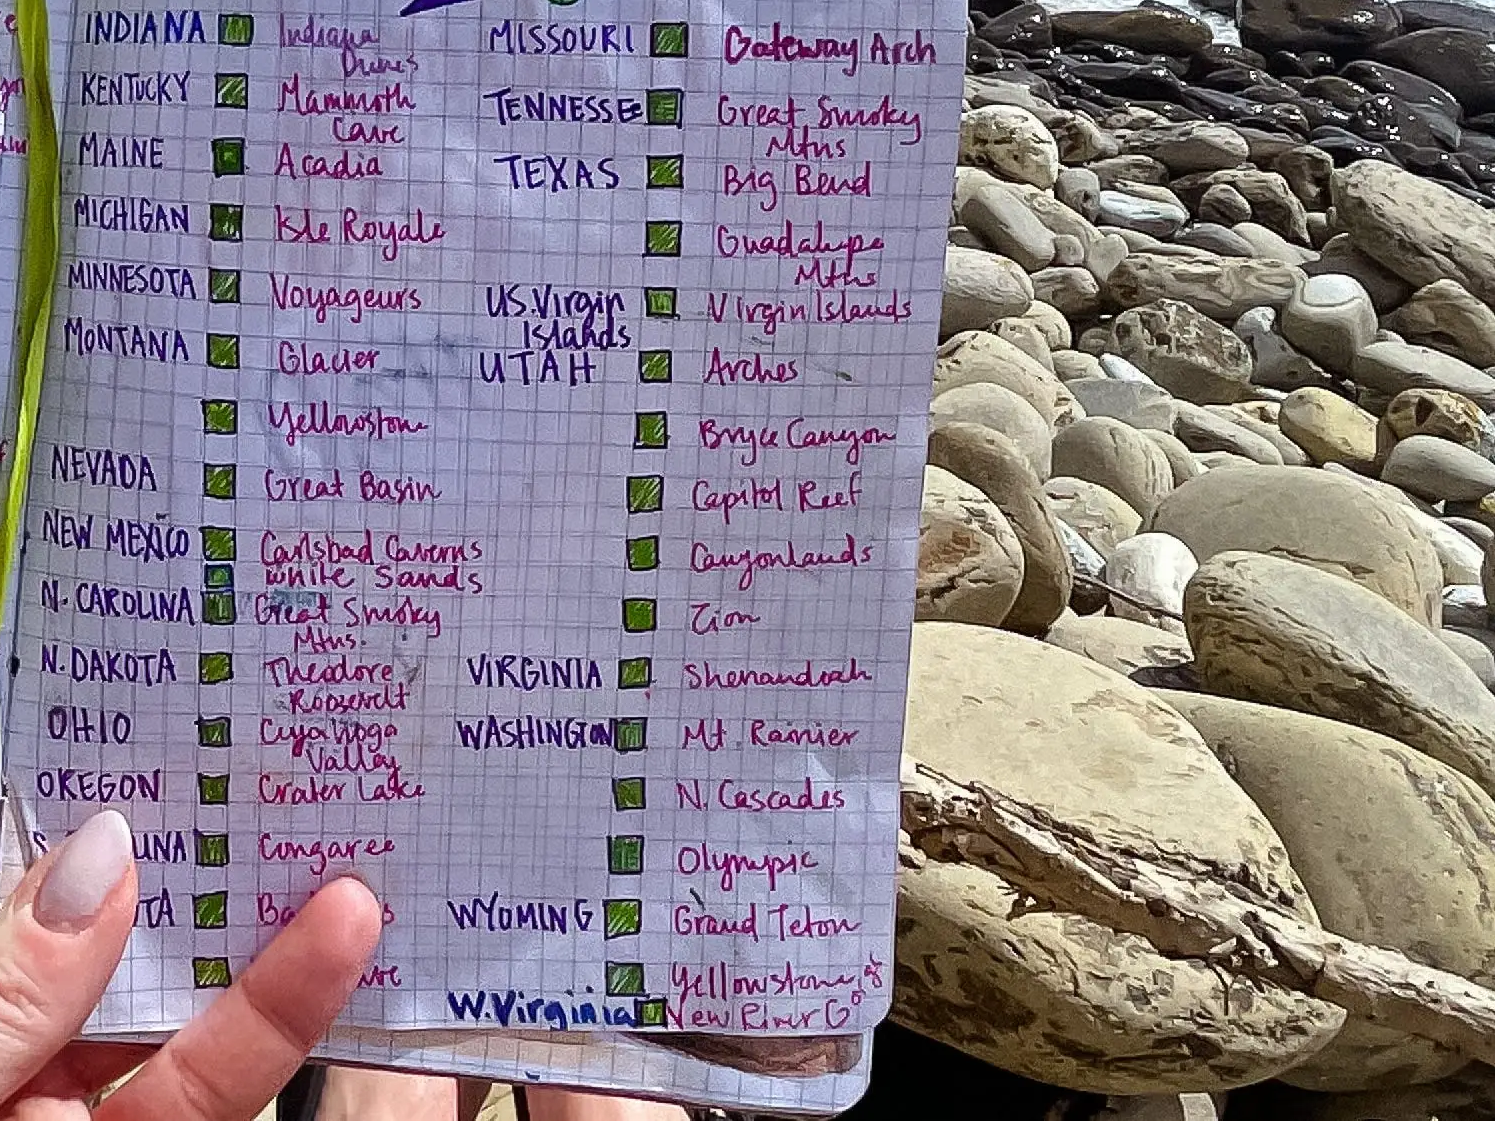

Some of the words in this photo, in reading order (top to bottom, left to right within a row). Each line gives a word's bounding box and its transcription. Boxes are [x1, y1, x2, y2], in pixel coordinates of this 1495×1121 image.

[85, 10, 206, 45] INDIANA
[279, 12, 380, 49] Indiana
[489, 21, 634, 54] MISSOURI
[724, 23, 858, 76] Gateway
[870, 31, 937, 64] Arch
[82, 71, 191, 106] KENTUCKY
[278, 73, 417, 116] Mammoth
[332, 117, 405, 143] Cave
[717, 95, 805, 129] Great
[817, 96, 921, 145] Smoky
[78, 133, 163, 169] MAINE
[275, 143, 383, 179] Acadia
[766, 126, 847, 160] Mtns
[494, 154, 620, 193] TEXAS
[724, 164, 777, 212] Big
[795, 162, 871, 197] Bend
[75, 199, 189, 233] MICHIGAN
[344, 207, 447, 261] Royale
[68, 263, 197, 299] MINNESOTA
[270, 273, 422, 323] Voyageurs
[708, 292, 806, 336] Virgin
[817, 289, 912, 324] Islands
[64, 318, 190, 362] MONTANA
[523, 319, 632, 351] Islands
[278, 340, 380, 375] Glacier
[480, 349, 596, 386] UTAH
[704, 347, 799, 386] Arches
[267, 400, 429, 447] Yellowstone
[699, 419, 779, 466] Bryce
[787, 419, 897, 465] Canyon
[51, 445, 157, 491] NEVADA
[265, 470, 345, 501] Great
[359, 471, 442, 503] Basin
[692, 480, 782, 524] Capitol
[799, 473, 863, 513] Reef
[43, 509, 94, 550] NEW
[261, 529, 374, 566] Carlsbad
[385, 534, 483, 563] Caverns
[375, 562, 483, 594] Sands
[691, 534, 873, 590] Canyonlands
[41, 580, 69, 613] N.
[76, 583, 196, 626] CAROLINA
[255, 593, 330, 625] Great
[343, 596, 441, 639] Smoky
[691, 603, 761, 636] Zion
[71, 647, 176, 687] DAKOTA
[264, 654, 393, 687] Theodore
[466, 654, 602, 691] VIRGINIA
[683, 658, 872, 690] Shenandoah
[289, 682, 410, 714] Roosevelt
[47, 705, 131, 744] OHIO
[457, 715, 613, 750] WASHINGTON
[750, 721, 859, 746] Rainier
[306, 743, 400, 785] Valley
[37, 767, 160, 804] OREGON
[259, 774, 346, 805] Crater
[358, 776, 425, 802] Lake
[718, 778, 846, 811] Cascades
[259, 833, 395, 875] Congaree
[678, 841, 819, 891] Olympic
[447, 891, 593, 935] WYOMING
[674, 903, 759, 943] Grand
[773, 904, 862, 941] Teton
[672, 961, 856, 1003] Yellowstone
[667, 999, 730, 1029] New
[742, 1002, 821, 1031] River
